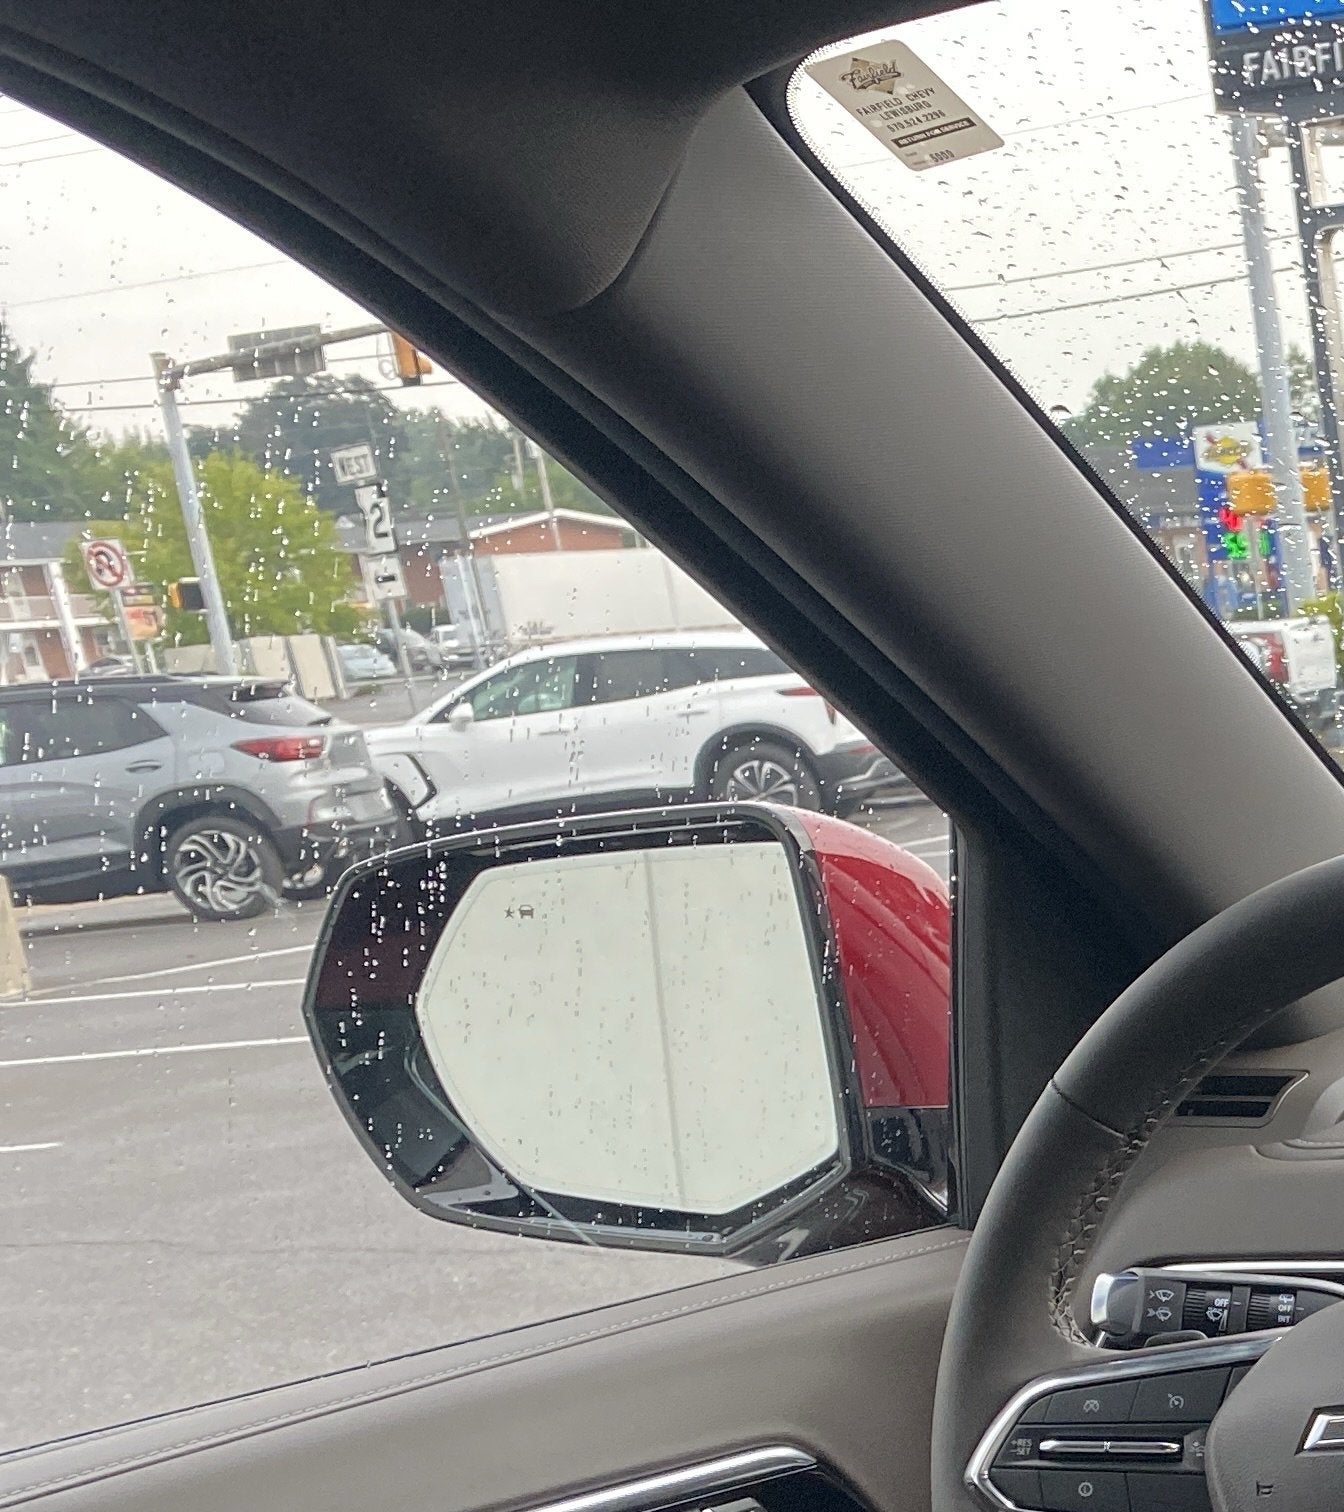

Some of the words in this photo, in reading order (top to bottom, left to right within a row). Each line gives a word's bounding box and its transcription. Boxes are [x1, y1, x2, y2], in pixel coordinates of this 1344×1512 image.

[856, 97, 903, 117] FAIRFIELD
[905, 87, 936, 102] CHEVY
[879, 100, 933, 121] LEWISBURG
[925, 128, 942, 138] FOR
[928, 149, 956, 163] 5000
[337, 453, 370, 476] WEST
[1214, 1297, 1230, 1308] OFF
[1277, 1304, 1293, 1313] OFF
